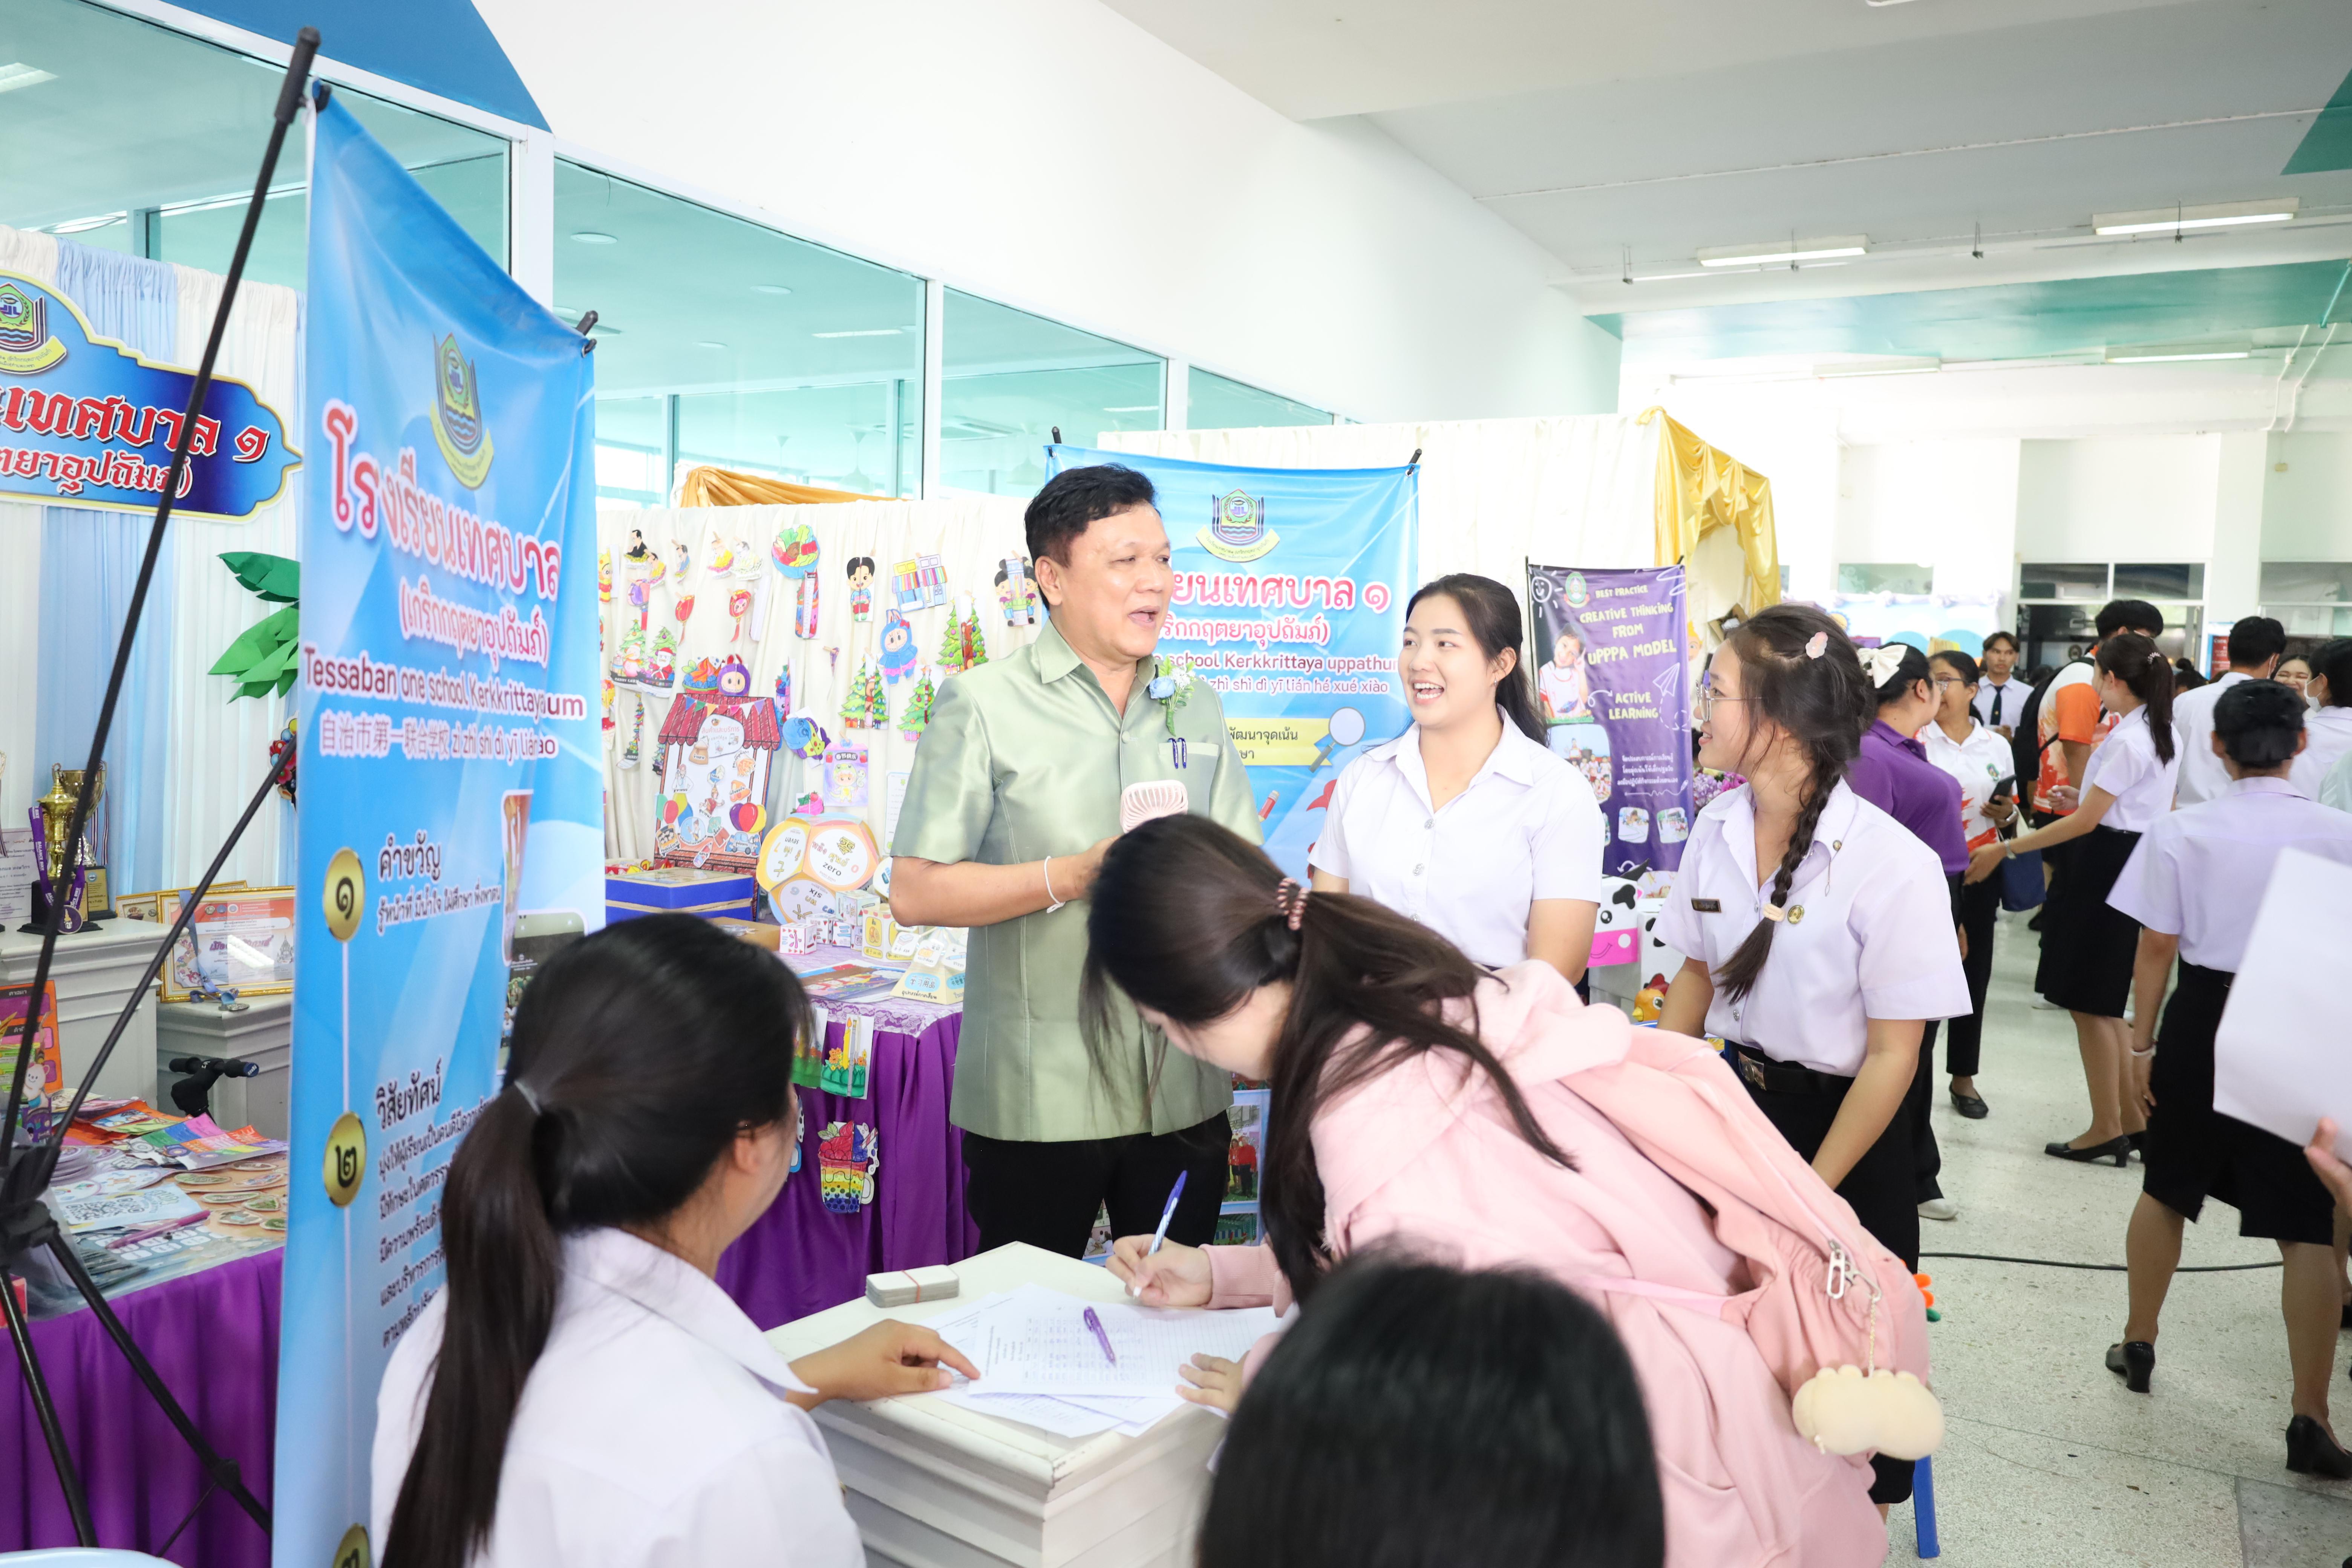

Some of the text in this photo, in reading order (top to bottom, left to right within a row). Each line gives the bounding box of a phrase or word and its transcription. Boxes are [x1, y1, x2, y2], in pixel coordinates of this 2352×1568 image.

[0, 386, 270, 462] เทศบาล ๑
[326, 407, 560, 596] โรงเรียนเทศบาล
[1173, 575, 1388, 610] ยนเทศบาล ๑
[1595, 589, 1613, 599] BEST
[401, 581, 548, 668] (เกริกกฤตยาอุปถัมภ์)
[1162, 613, 1329, 646] ริกกฤตยาอุปถัมภ์)
[1612, 623, 1644, 639] FROM
[1633, 639, 1677, 658] MODEL
[305, 647, 397, 695] Tessaban
[401, 671, 426, 699] one
[429, 670, 469, 705] school
[1225, 654, 1322, 673] Kerkkrittaya
[1233, 678, 1251, 691] shì
[1256, 678, 1266, 691] dì
[1287, 679, 1311, 691] lián
[1315, 679, 1329, 691] hé
[1334, 680, 1357, 692] xué
[1361, 680, 1388, 692] xiào
[1239, 750, 1254, 759] ษา
[785, 836, 799, 845] seven
[380, 831, 440, 880] คำขวัญ
[822, 862, 842, 876] zero
[335, 876, 355, 920] ๑
[809, 888, 823, 898] six
[910, 978, 936, 989] 学习用品
[376, 1057, 442, 1130] วิสัยทัศน์
[335, 1145, 357, 1188] ๒
